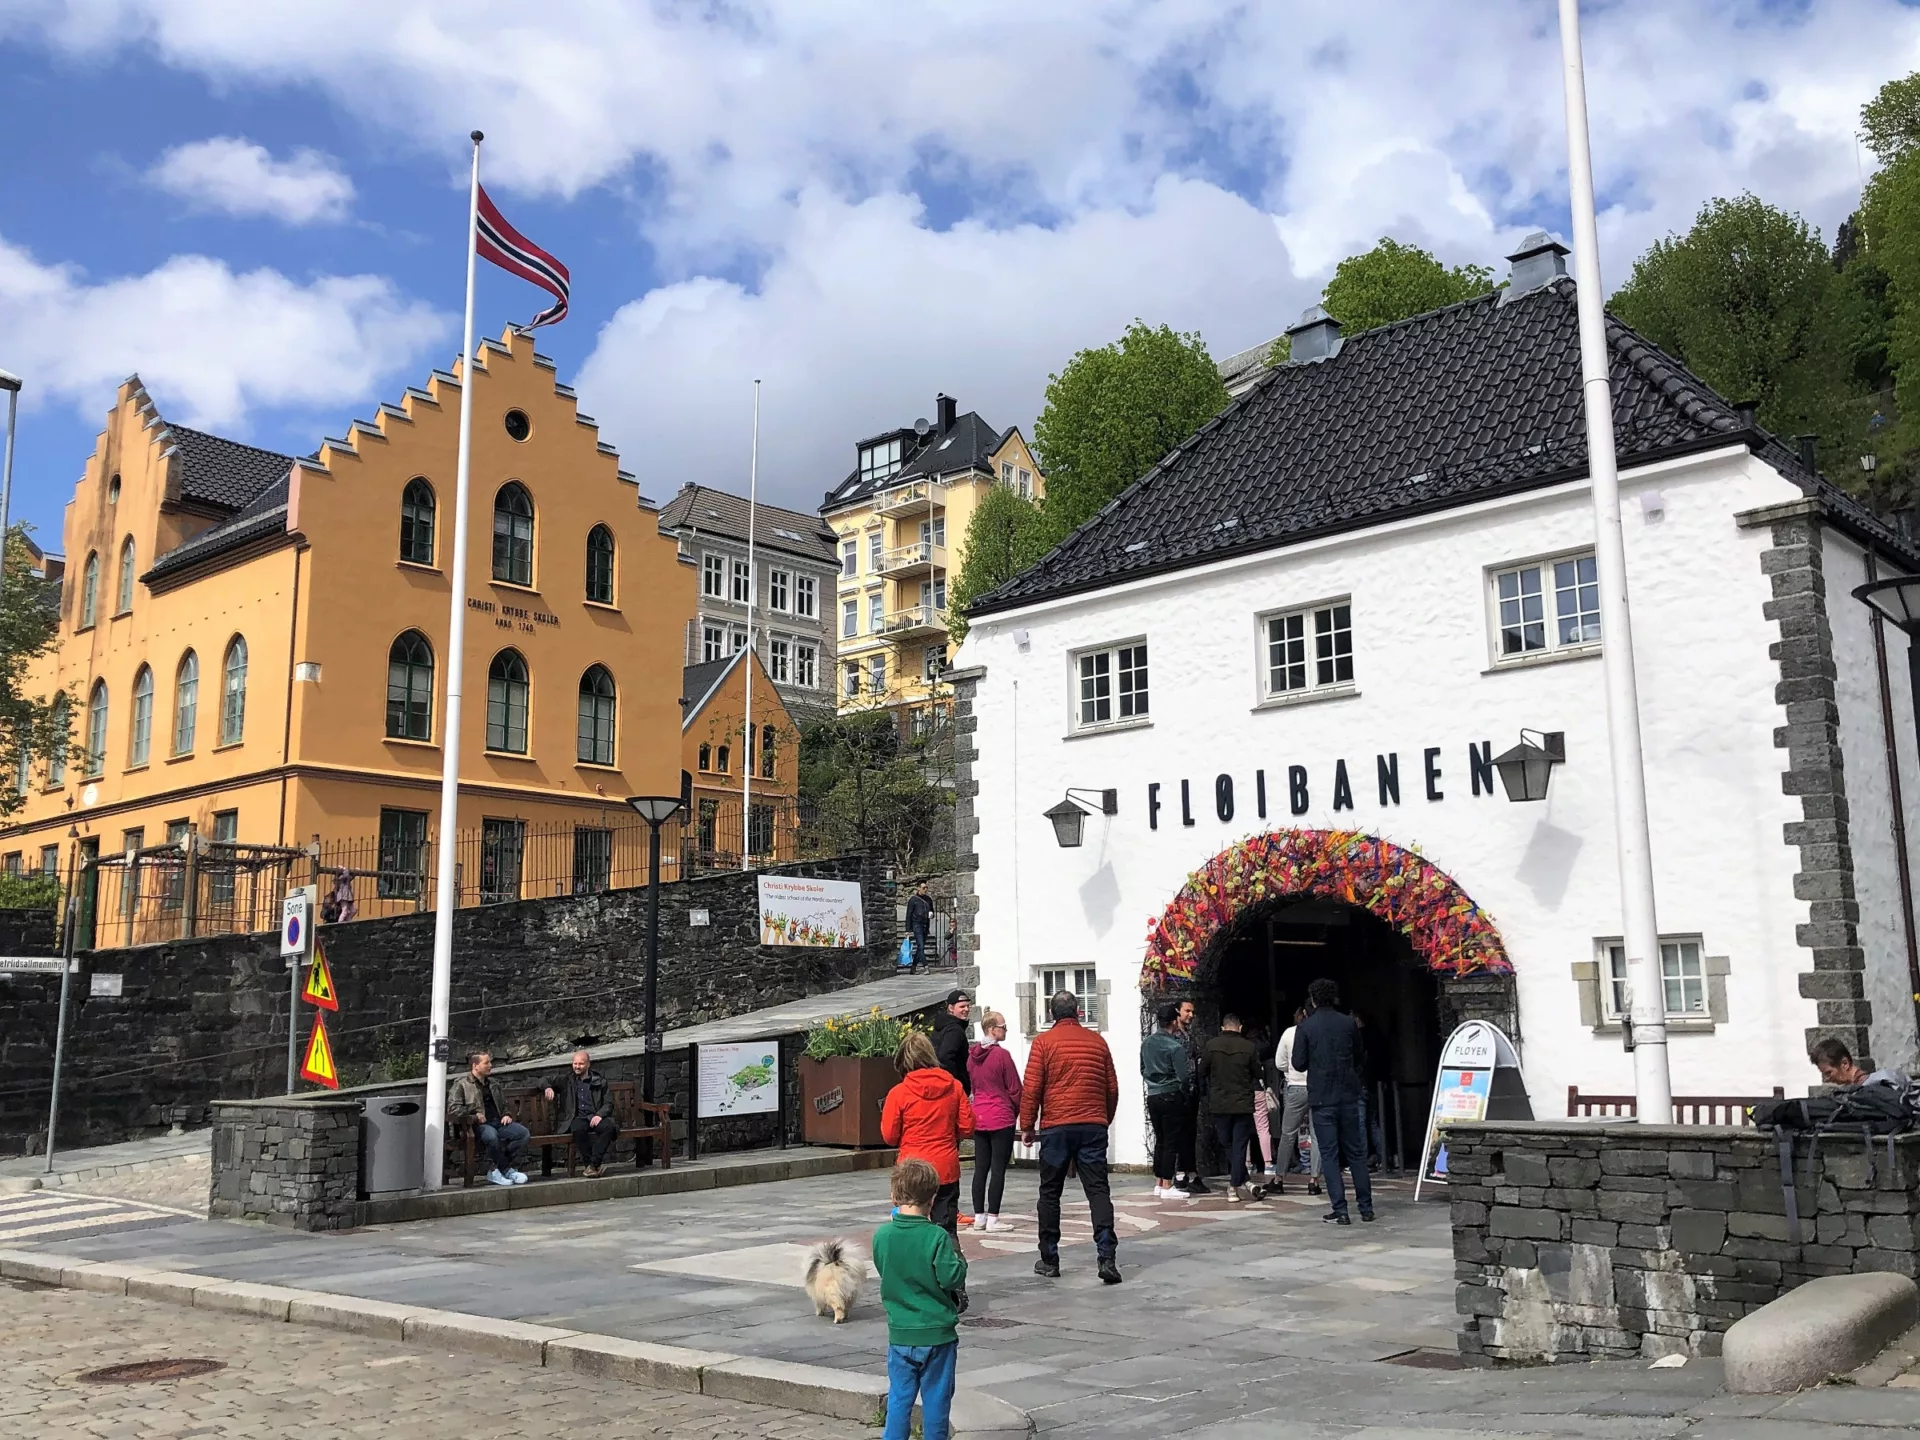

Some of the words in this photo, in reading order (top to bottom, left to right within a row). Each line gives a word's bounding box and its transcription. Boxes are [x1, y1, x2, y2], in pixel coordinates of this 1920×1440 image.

[467, 598, 496, 612] CHRISTI
[502, 605, 528, 619] KRYBBE
[533, 611, 559, 625] SKOLER
[1149, 741, 1494, 829] FLØIBANEN
[287, 902, 302, 915] Sone
